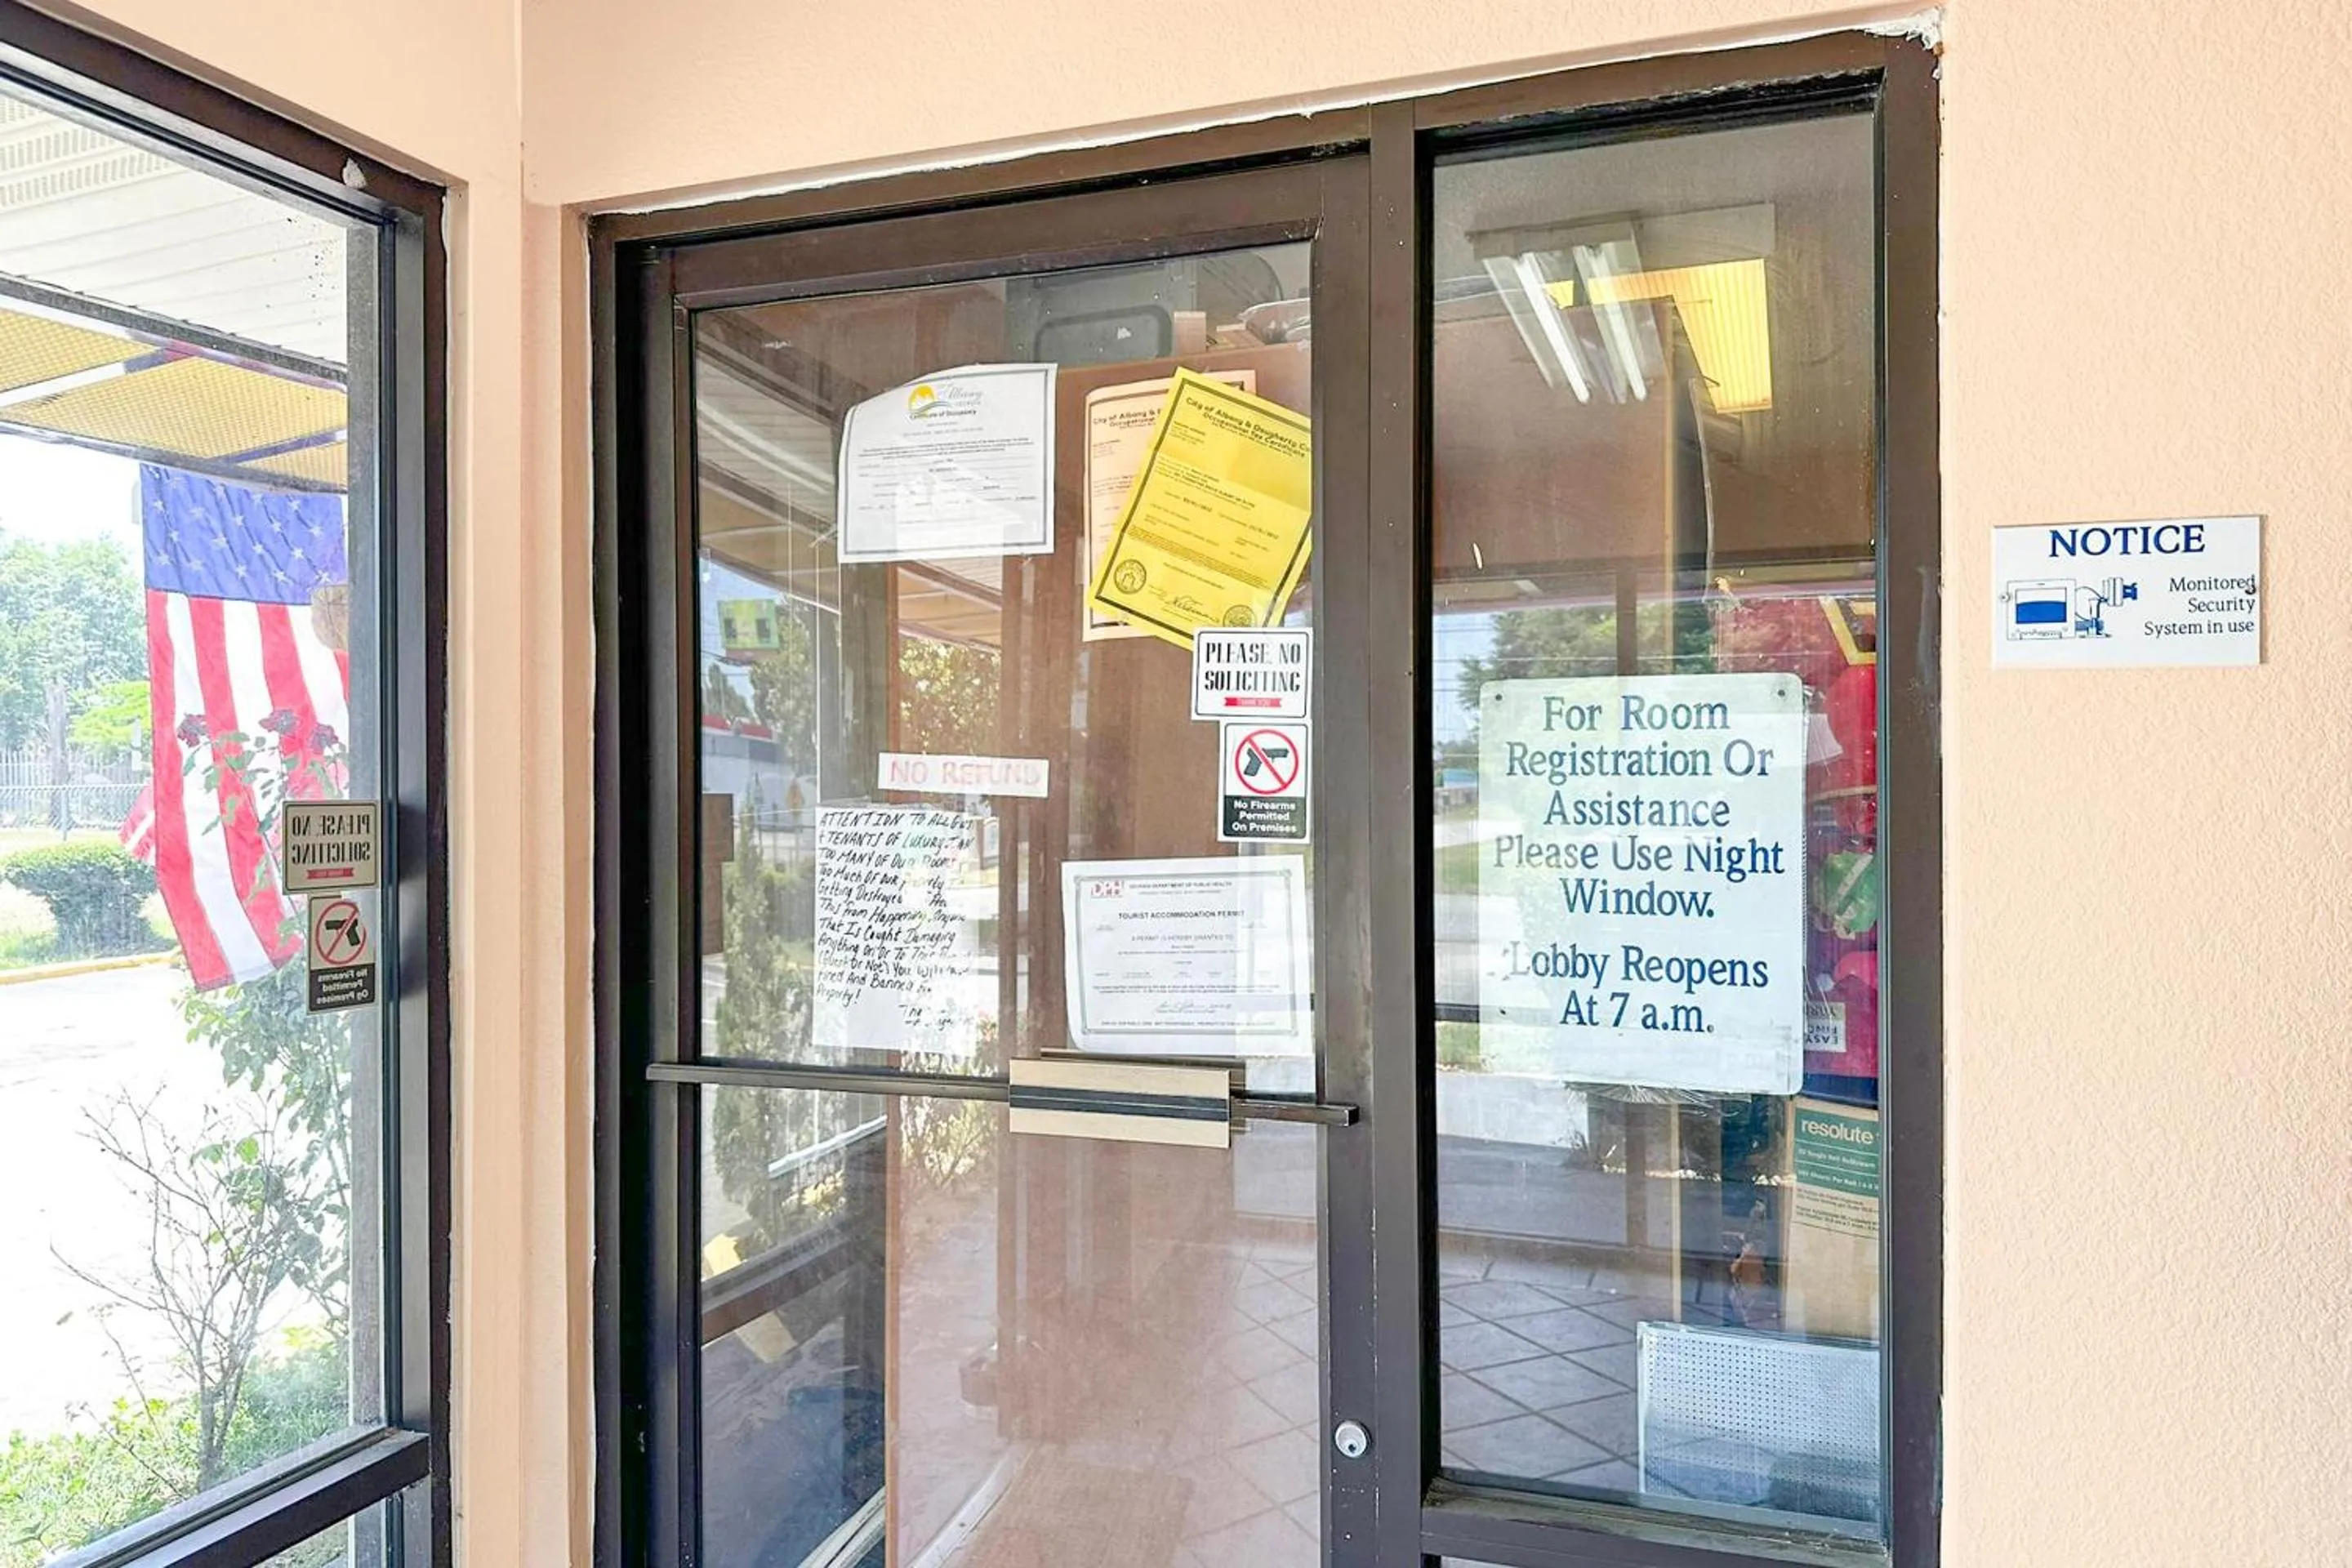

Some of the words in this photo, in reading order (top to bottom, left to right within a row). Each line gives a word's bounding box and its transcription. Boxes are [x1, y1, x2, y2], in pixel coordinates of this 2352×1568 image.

[2048, 523, 2205, 557] NOTICE
[2169, 575, 2256, 594] Monitored
[2189, 596, 2255, 613] Security
[2145, 621, 2203, 639] System
[2207, 621, 2224, 634] in
[2228, 621, 2254, 634] use
[1206, 642, 1272, 664] PLEASE
[1280, 643, 1302, 665] NO
[1205, 670, 1301, 693] SOLICITING
[1543, 697, 1601, 731] For
[1621, 695, 1730, 731] Room
[891, 760, 929, 785] NO
[1506, 741, 1711, 786] Registration
[1724, 739, 1775, 777] Or
[1233, 800, 1248, 810] No
[1250, 800, 1296, 810] Firearms
[1240, 811, 1290, 821] Permitted
[1544, 790, 1731, 827] Assistance
[820, 811, 905, 827] ATTENTION
[910, 813, 926, 826] TO
[1232, 822, 1247, 832] On
[1250, 822, 1297, 833] Premises
[827, 831, 884, 847] TENANTS
[885, 831, 902, 845] OF
[837, 849, 875, 866] MANY
[875, 854, 890, 867] OF
[1493, 834, 1598, 869] Please
[1611, 835, 1673, 871] Use
[1684, 835, 1785, 883] Night
[1558, 877, 1715, 918] Window.
[1151, 911, 1216, 920] ACCOMMODATION
[1510, 940, 1610, 989] Lobby
[1621, 945, 1768, 994] Reopens
[1559, 991, 1599, 1027] At
[1610, 991, 1630, 1027] 7
[1642, 1003, 1714, 1033] a.m.
[1802, 1119, 1873, 1144] resolute
